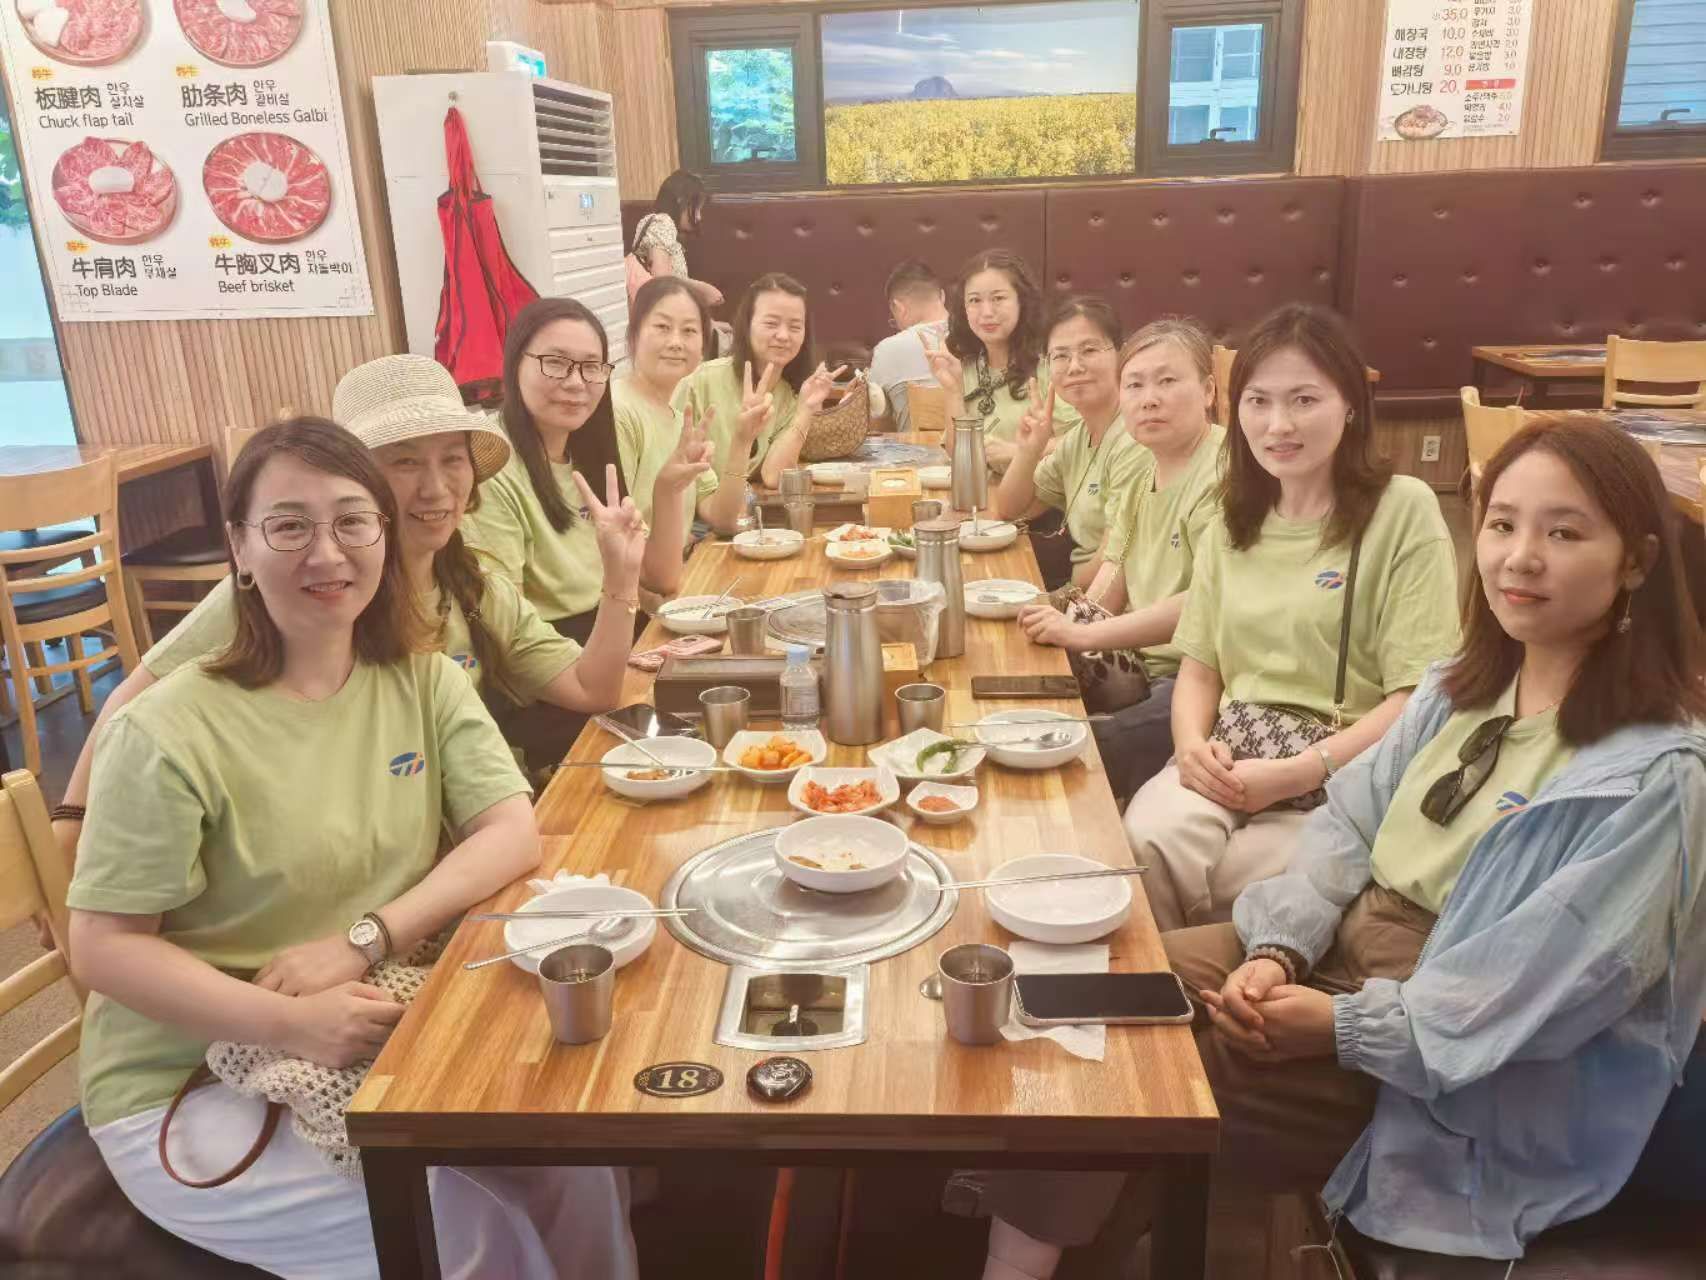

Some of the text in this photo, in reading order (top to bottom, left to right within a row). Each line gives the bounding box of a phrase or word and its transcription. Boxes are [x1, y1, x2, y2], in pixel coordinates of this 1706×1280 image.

[181, 82, 248, 108] 肋条肉
[1390, 82, 1433, 96] 도가니탕
[39, 112, 134, 129] Chuck flap tail
[184, 108, 328, 126] Grilled Boneless Galbi
[72, 256, 137, 279] 牛肩肉
[215, 252, 301, 275] 牛胸叉肉
[75, 283, 138, 299] Top Blade
[218, 279, 295, 293] Beef brisket
[656, 1069, 699, 1089] 18
